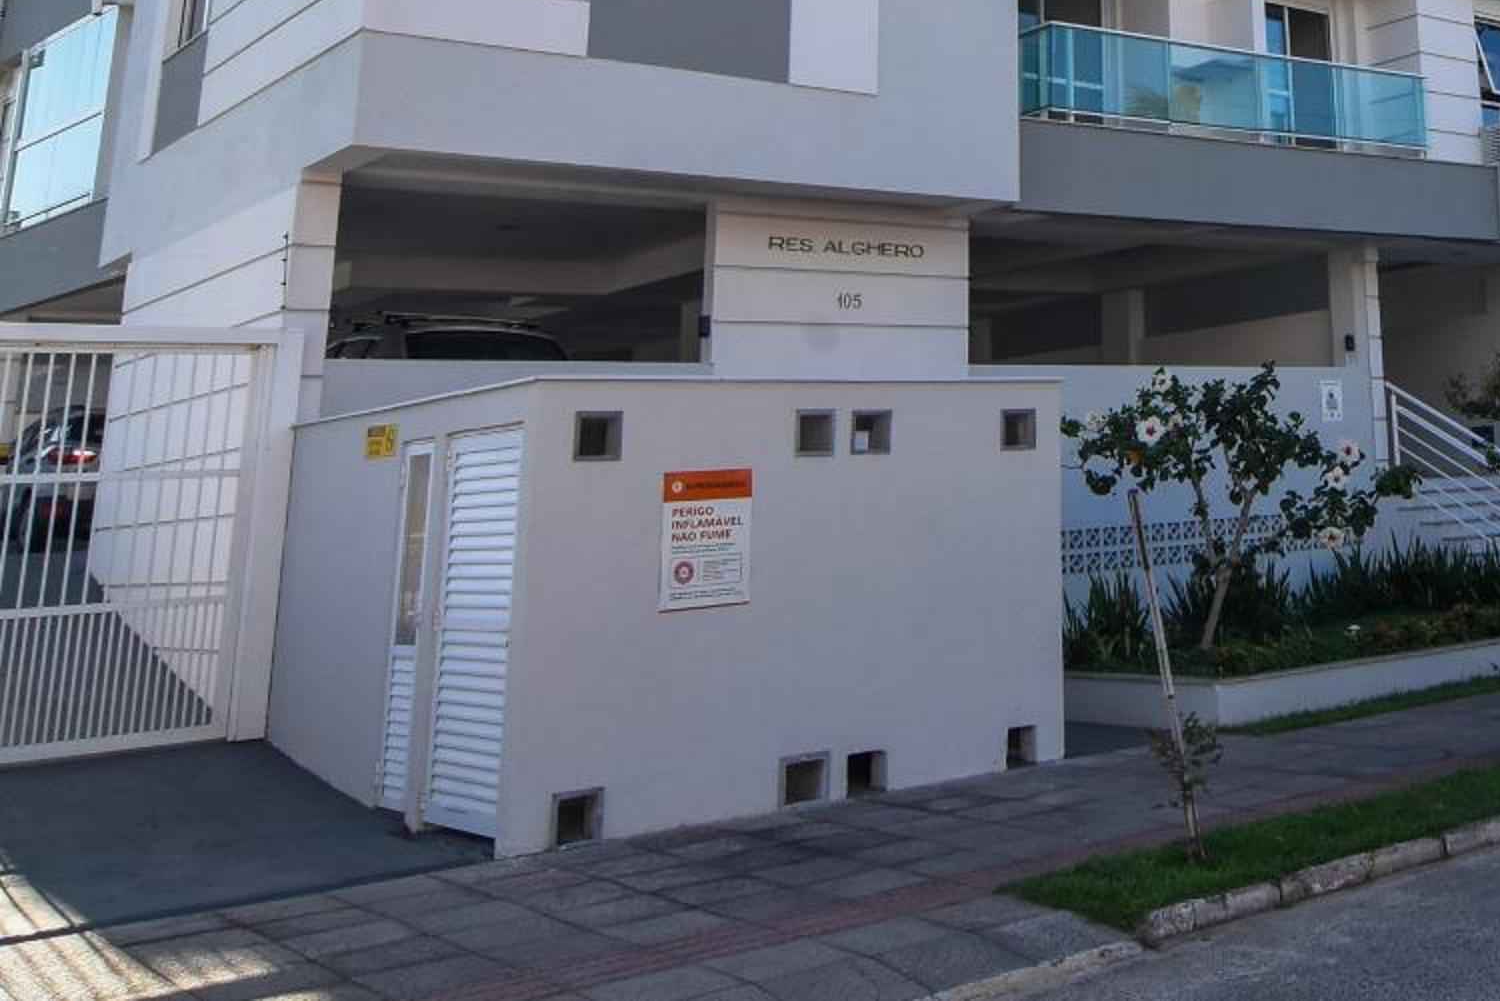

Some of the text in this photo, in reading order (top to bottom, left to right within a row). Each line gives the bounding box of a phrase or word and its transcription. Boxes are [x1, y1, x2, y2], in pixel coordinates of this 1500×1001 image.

[768, 236, 925, 258] RES ALGHERO
[837, 293, 862, 310] 105
[671, 505, 714, 517] PERIGO
